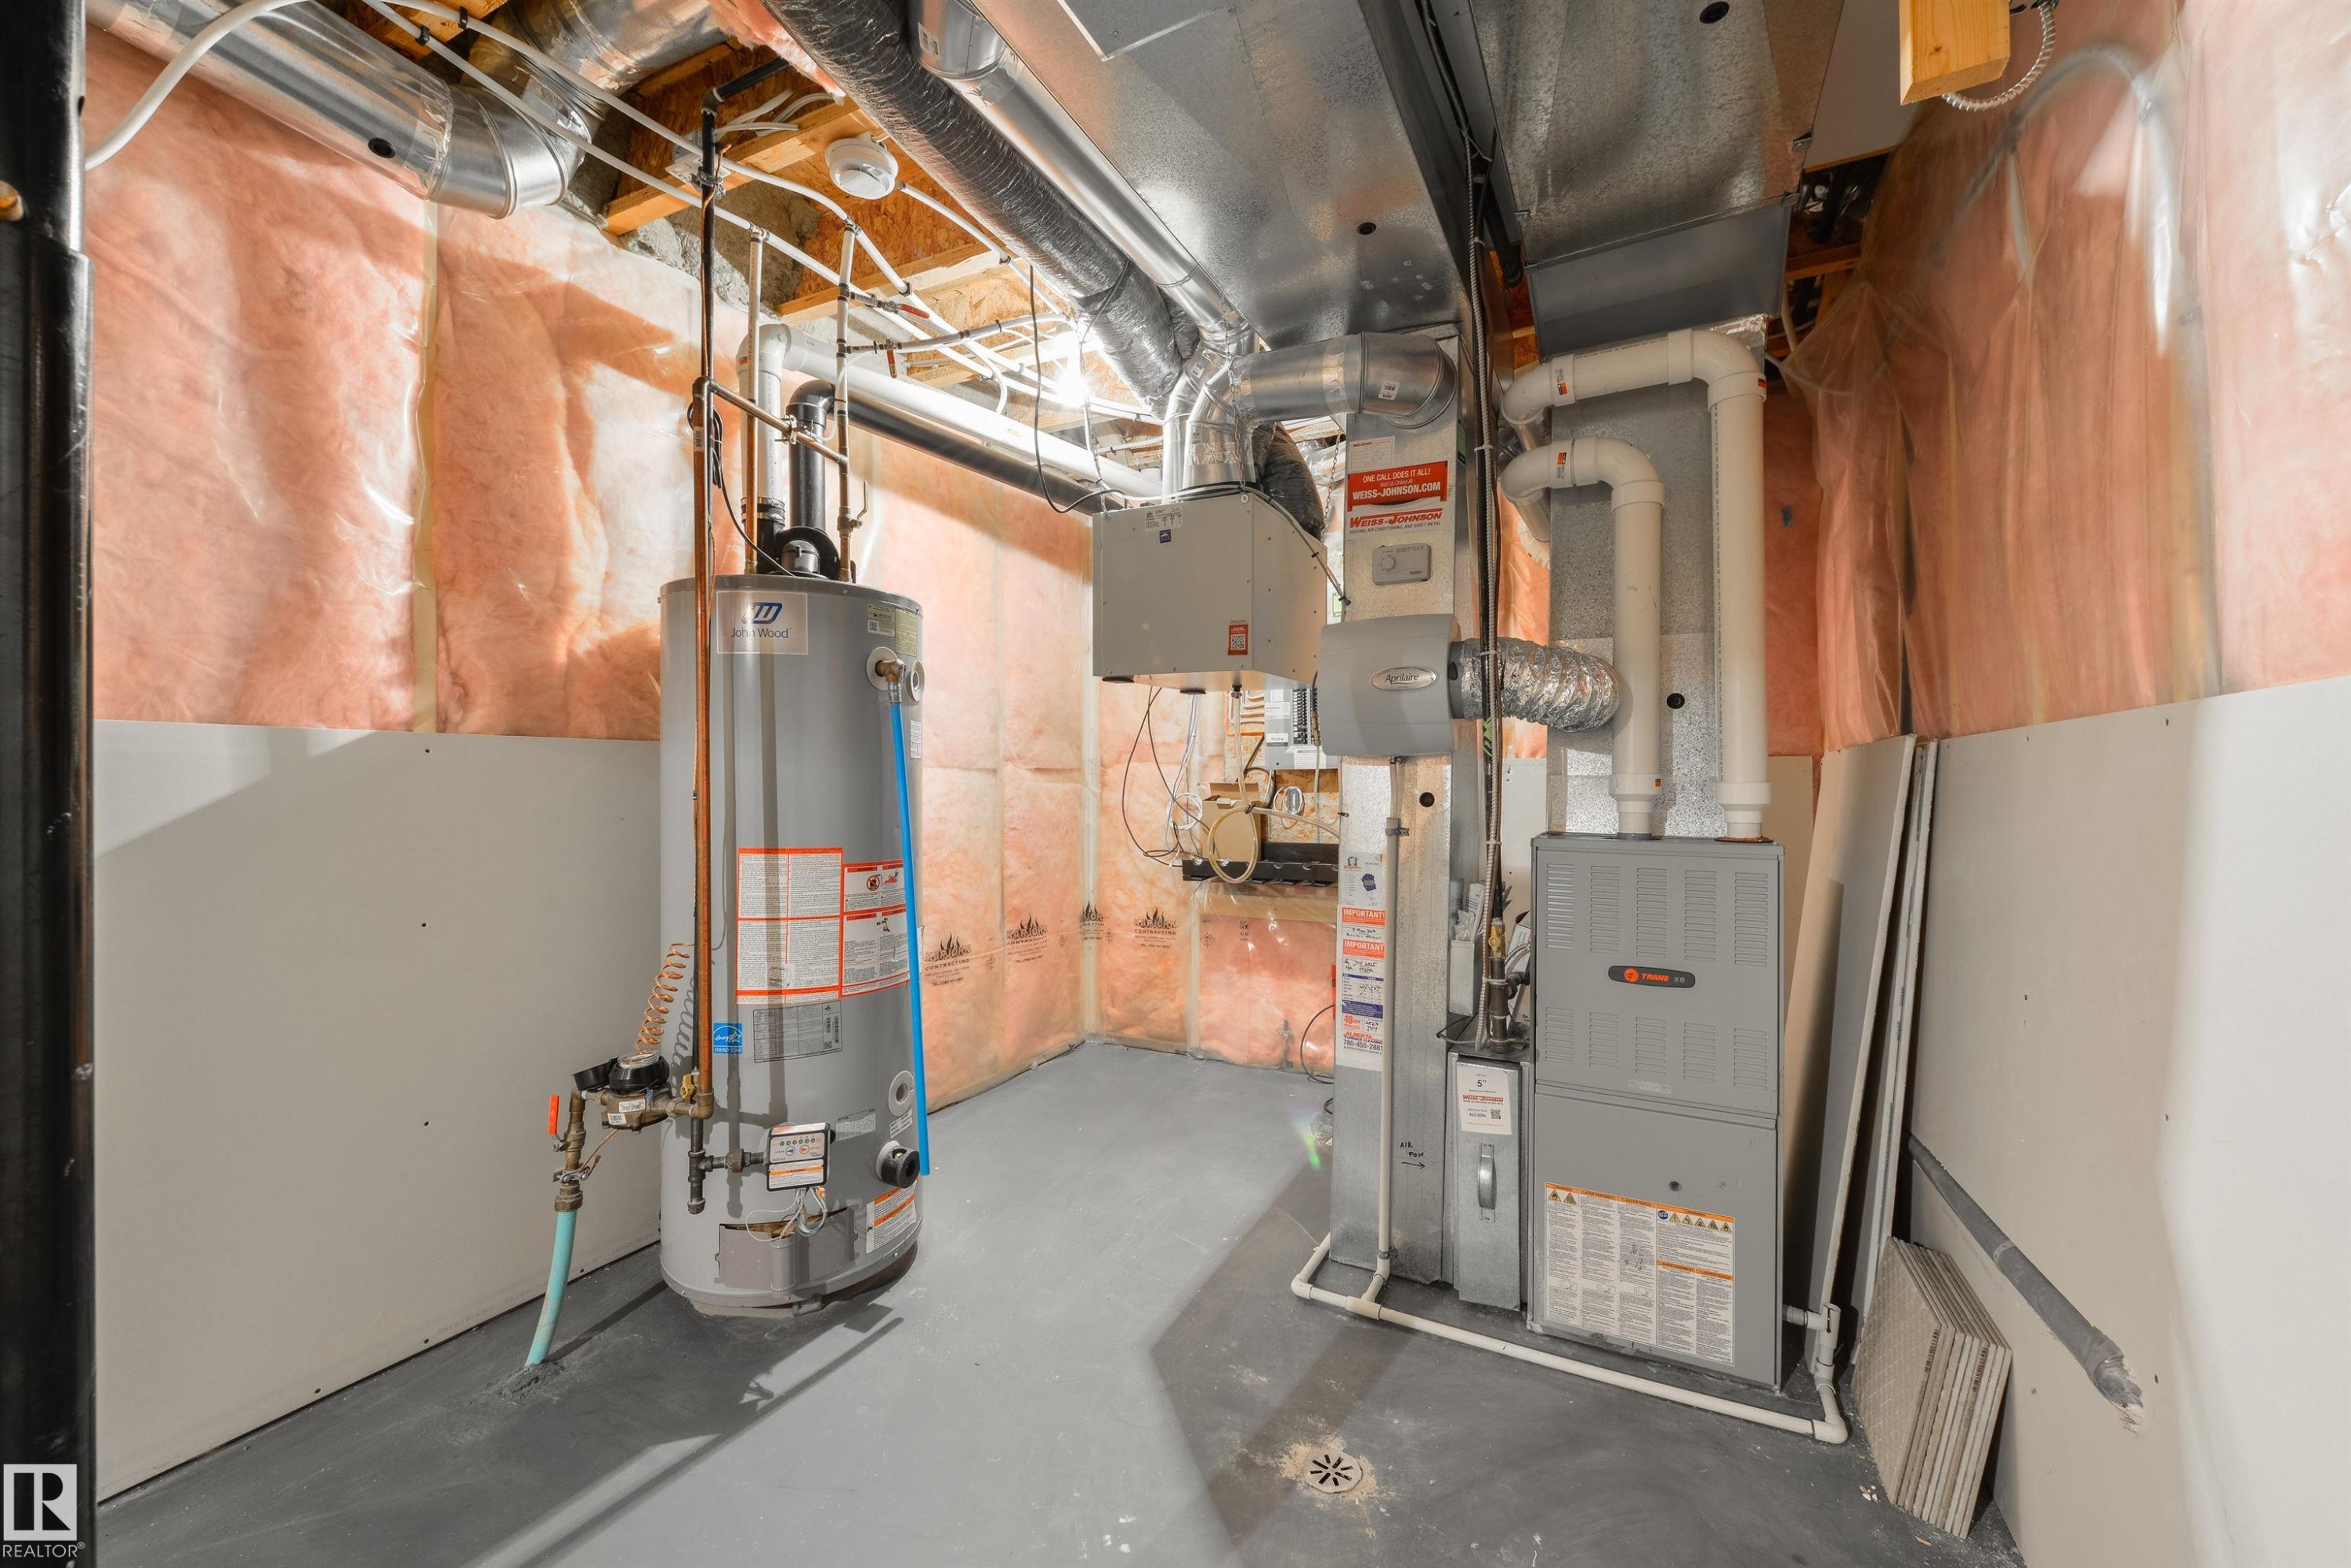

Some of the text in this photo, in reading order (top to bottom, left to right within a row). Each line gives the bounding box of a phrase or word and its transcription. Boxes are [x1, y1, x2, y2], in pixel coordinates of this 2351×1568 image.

[1393, 471, 1409, 480] DOES
[1417, 468, 1430, 476] ALL!
[1353, 482, 1441, 500] WEISS-JOHNSON.COM
[757, 628, 788, 639] Wood
[1385, 672, 1419, 685] Aprilaire
[1641, 972, 1670, 982] TRANE
